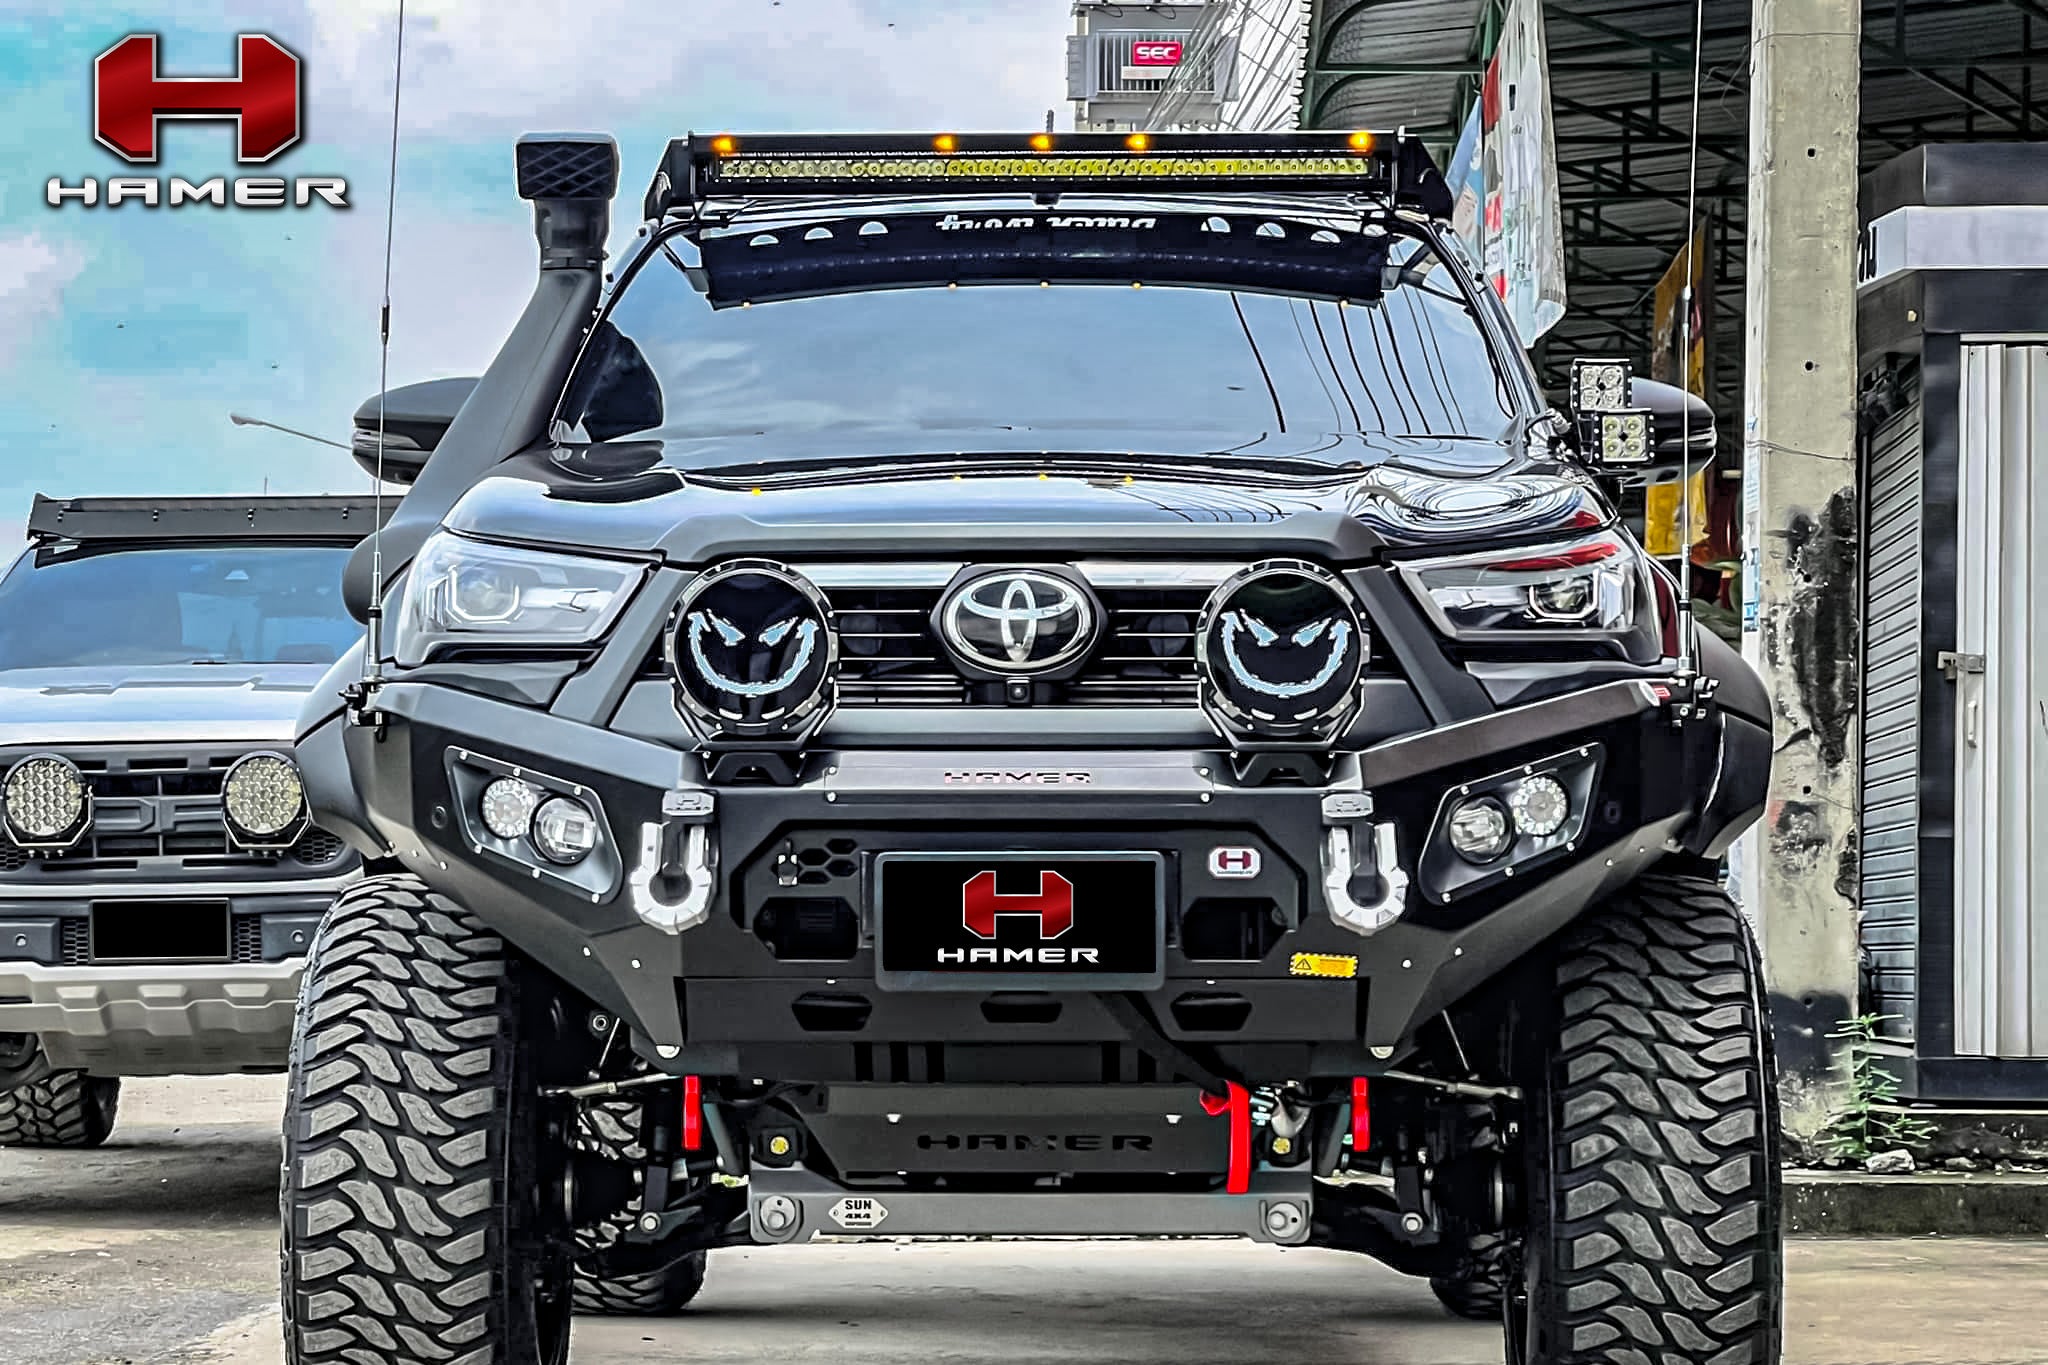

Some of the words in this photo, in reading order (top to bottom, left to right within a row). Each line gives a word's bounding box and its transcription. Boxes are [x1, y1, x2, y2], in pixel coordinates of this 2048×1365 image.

[1136, 46, 1177, 60] SEC
[944, 772, 1092, 784] HAMER
[917, 1134, 1153, 1151] HAMER
[845, 1200, 872, 1210] SUN
